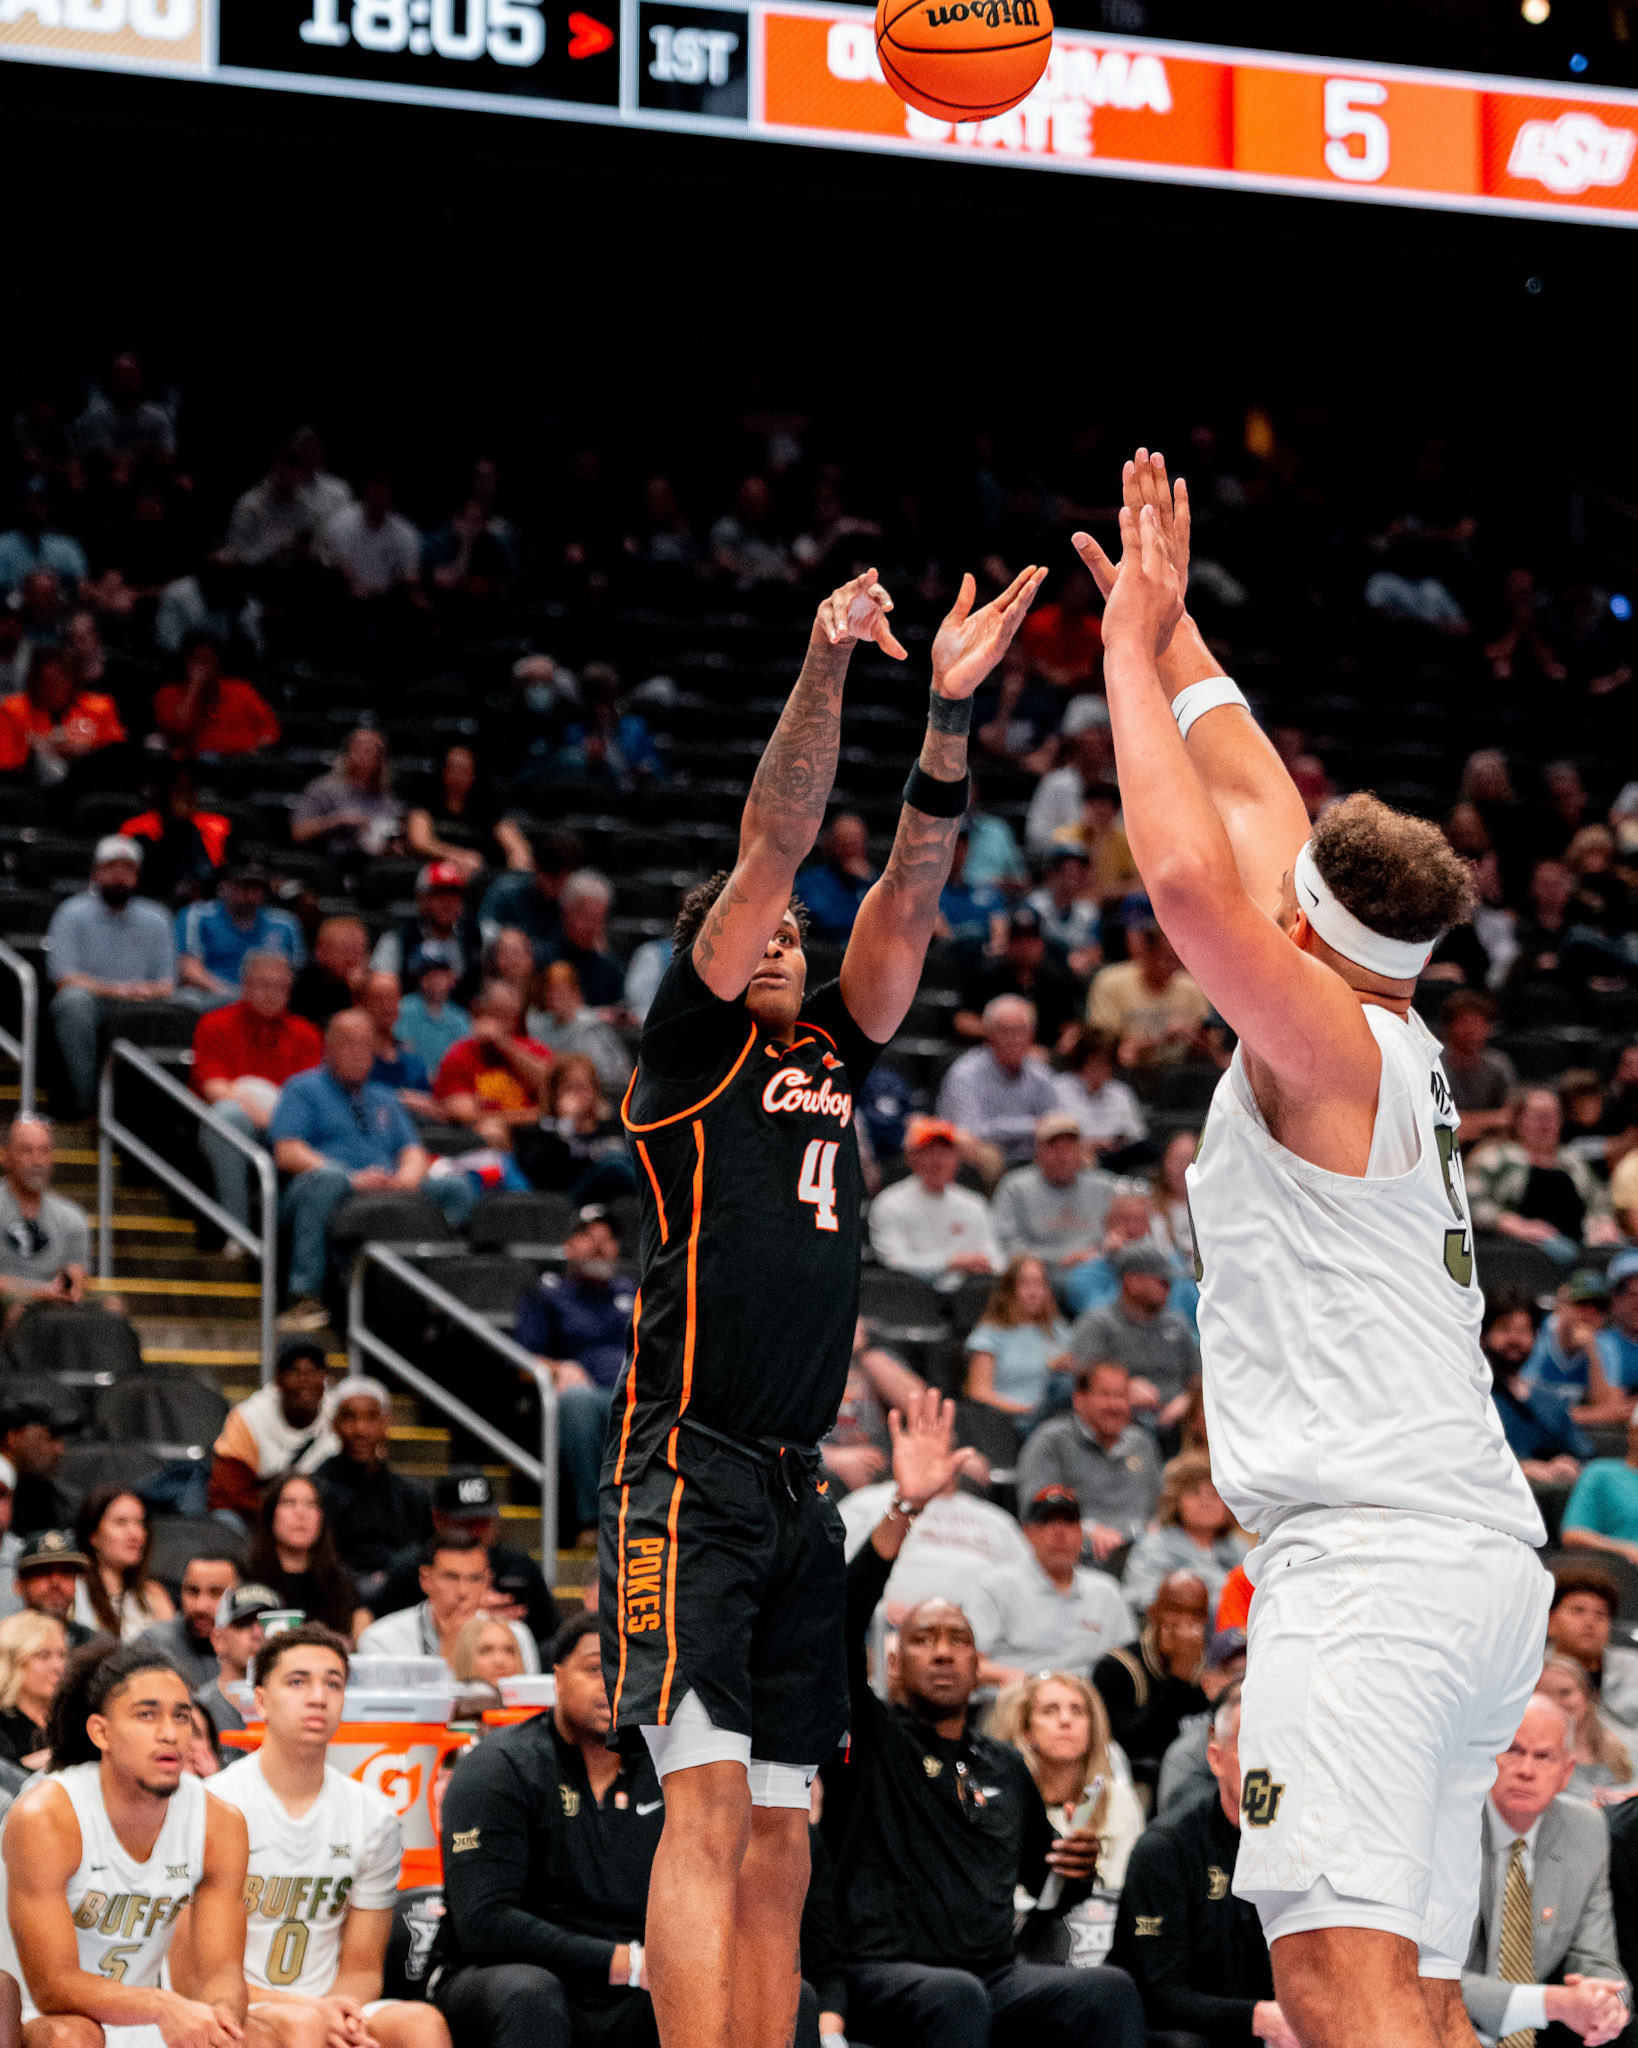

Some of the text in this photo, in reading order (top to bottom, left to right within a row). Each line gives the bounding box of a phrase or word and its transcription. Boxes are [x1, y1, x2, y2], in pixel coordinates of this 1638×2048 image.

[299, 0, 546, 67] 18:05
[926, 1, 1040, 27] Wilson
[649, 24, 739, 85] 1ST
[827, 23, 1173, 114] OOMA
[1324, 78, 1389, 182] 5
[798, 1138, 840, 1232] 4
[626, 1537, 665, 1634] POKES
[243, 1875, 353, 1920] BUFFS
[98, 1943, 143, 1982] 5
[265, 1918, 310, 1985] 0
